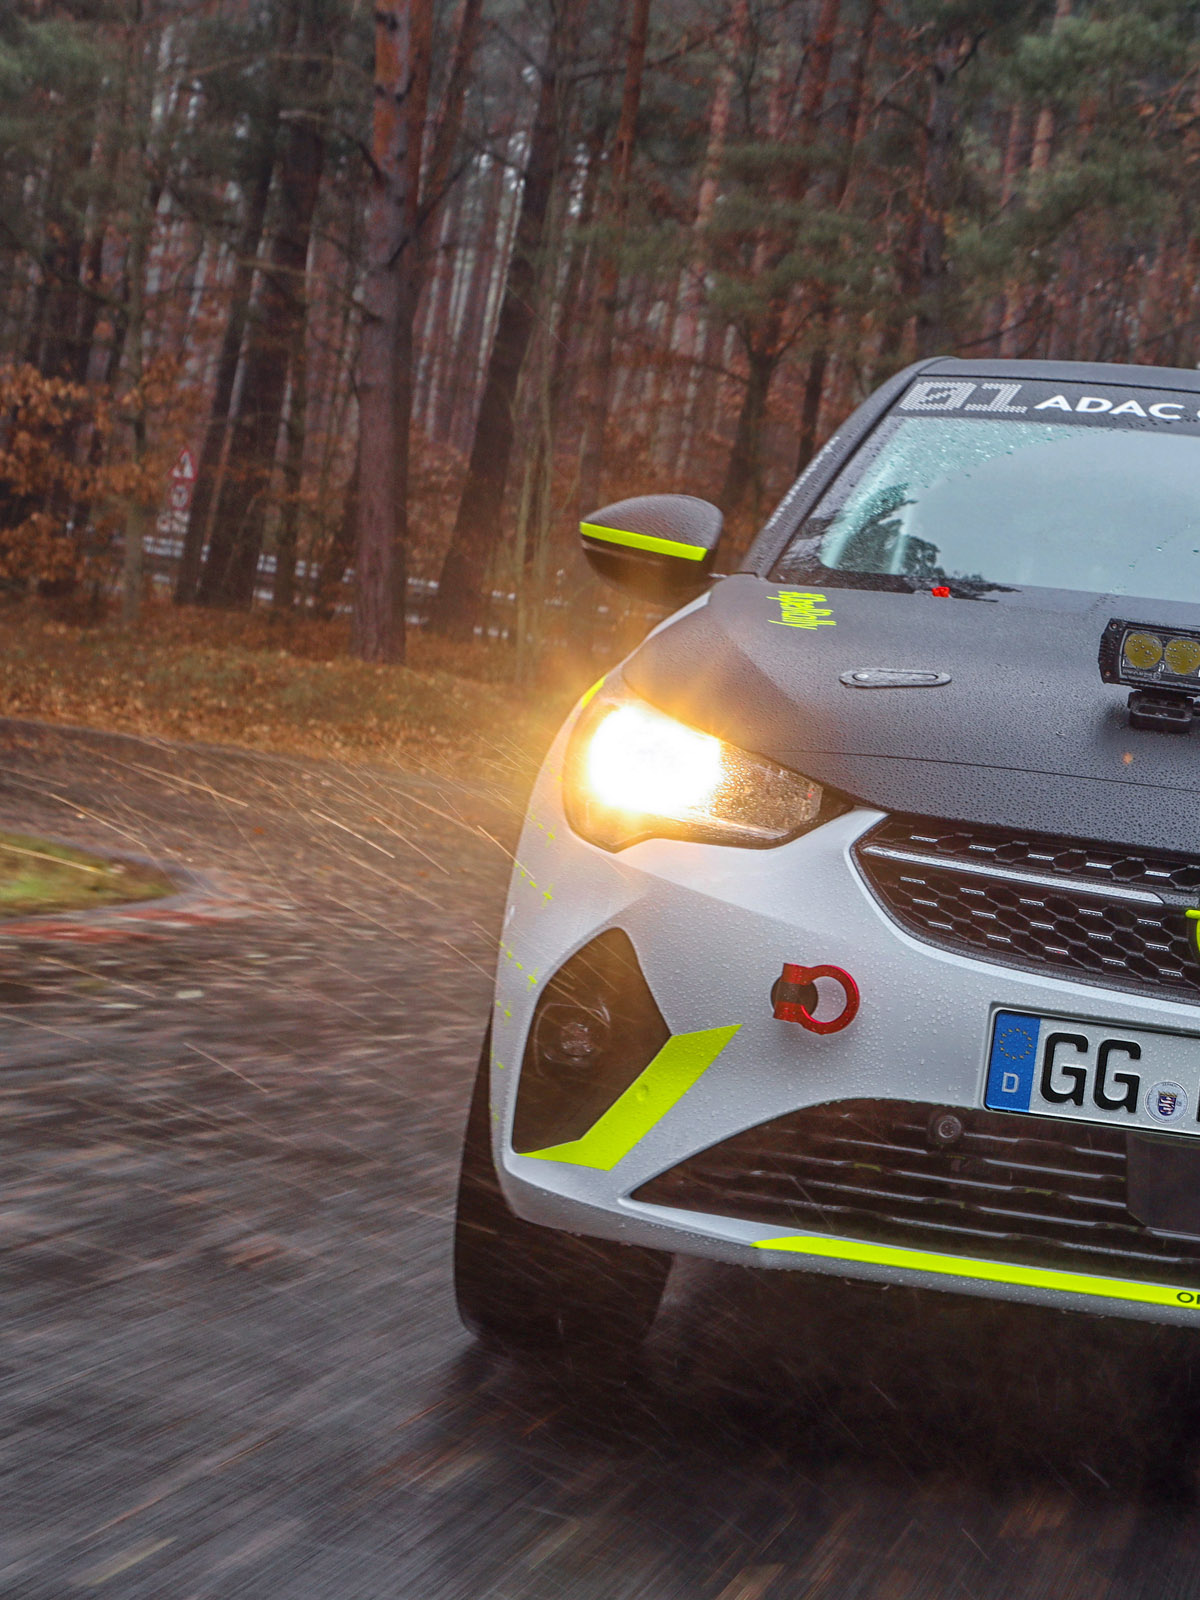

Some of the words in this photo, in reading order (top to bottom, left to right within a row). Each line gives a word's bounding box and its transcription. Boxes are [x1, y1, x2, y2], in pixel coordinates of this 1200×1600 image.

[1033, 394, 1186, 420] ADAC
[1001, 1071, 1019, 1093] D
[1040, 1031, 1142, 1113] GG
